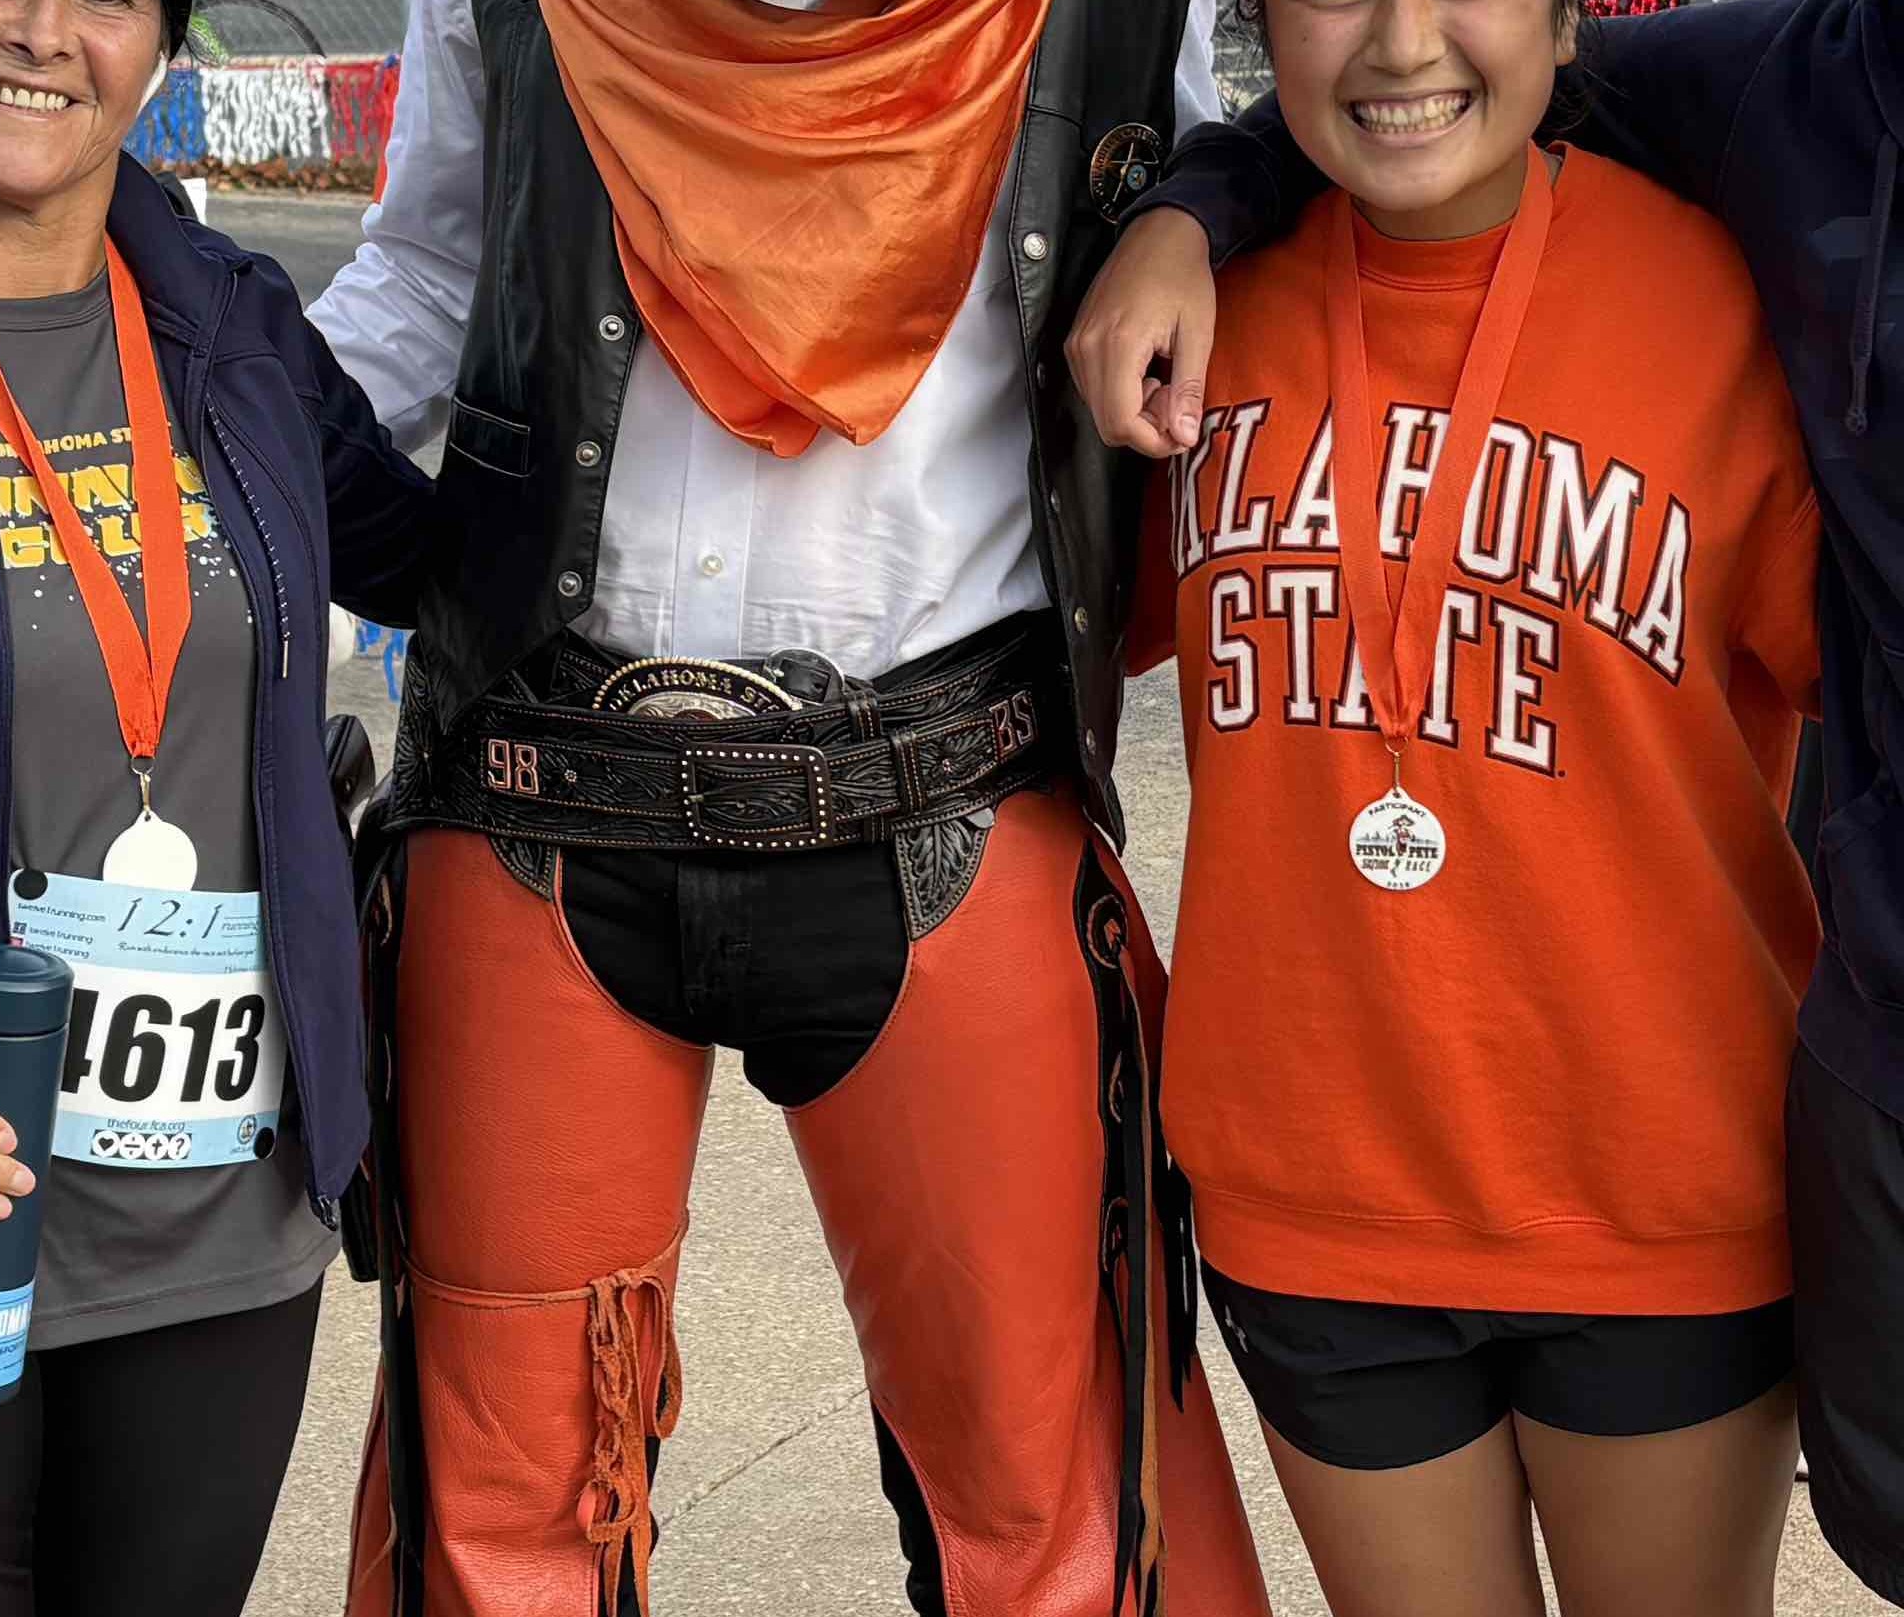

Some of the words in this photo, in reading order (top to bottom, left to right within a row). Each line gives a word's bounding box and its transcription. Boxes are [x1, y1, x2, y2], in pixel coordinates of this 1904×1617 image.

[1169, 397, 1694, 687] KLAHOMA
[608, 668, 734, 713] OKLAHOMA
[487, 738, 541, 795] 98
[1356, 844, 1396, 857] PISTOL
[1408, 846, 1439, 859] PETE
